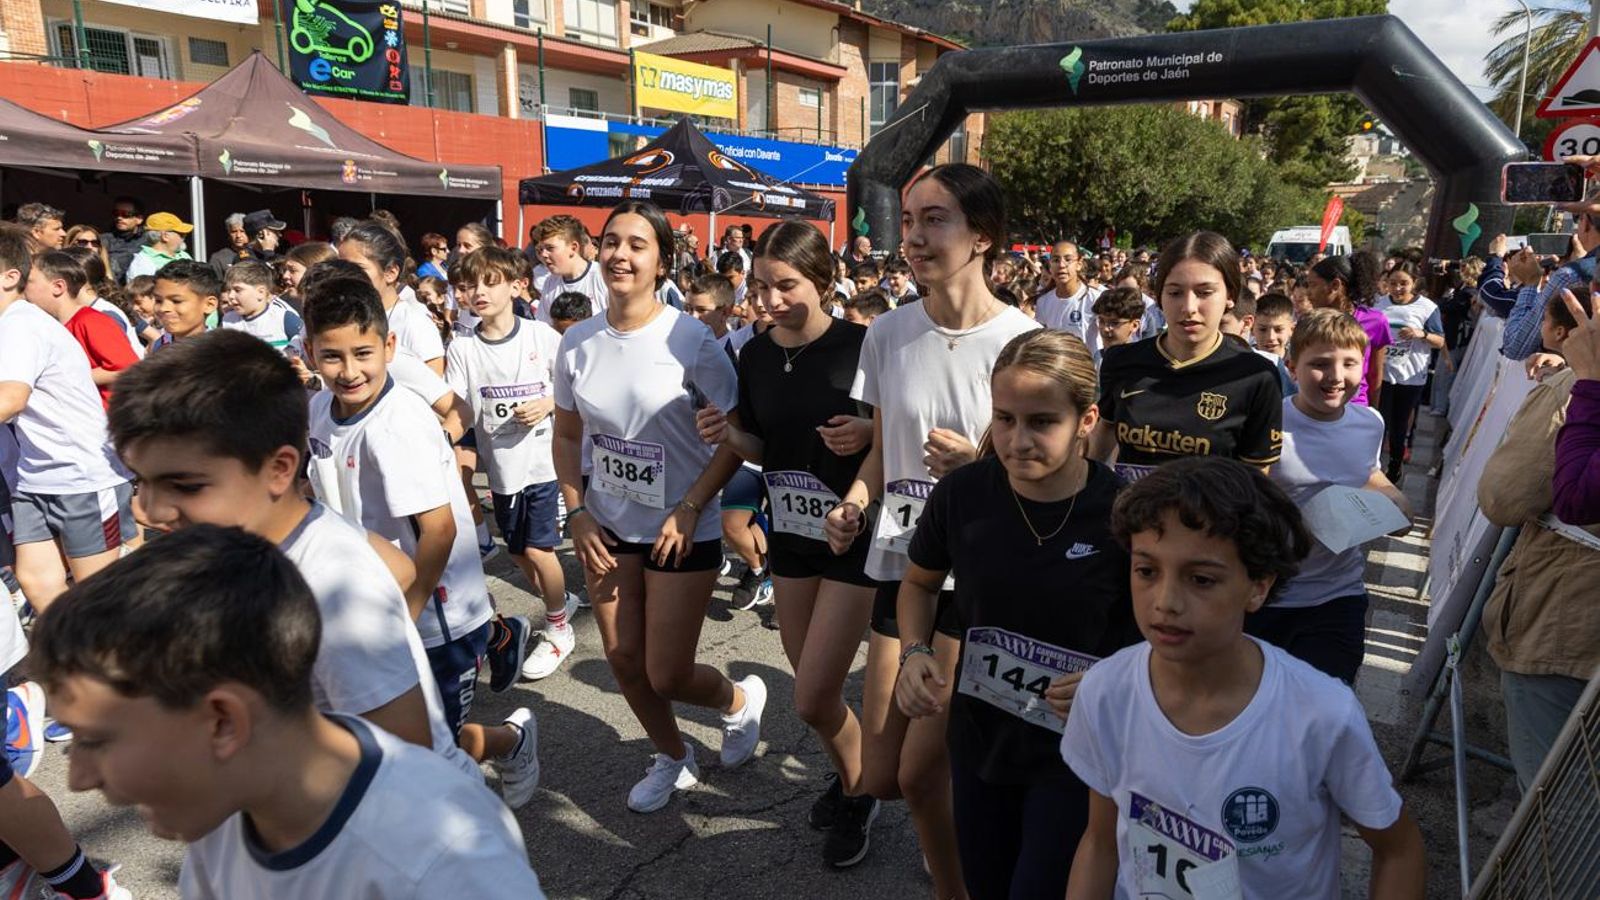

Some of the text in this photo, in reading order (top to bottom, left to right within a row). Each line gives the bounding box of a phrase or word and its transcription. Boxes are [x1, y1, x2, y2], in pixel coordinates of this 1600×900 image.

[1089, 51, 1223, 71] Patronato Municipal de
[660, 71, 733, 99] masymas
[1088, 67, 1190, 86] Deportes de Jaén
[724, 146, 744, 157] oficial
[757, 149, 781, 161] Davante
[1560, 137, 1600, 157] 30
[585, 186, 623, 197] cruzando
[1118, 422, 1211, 456] Rakuten
[602, 455, 654, 486] 1384
